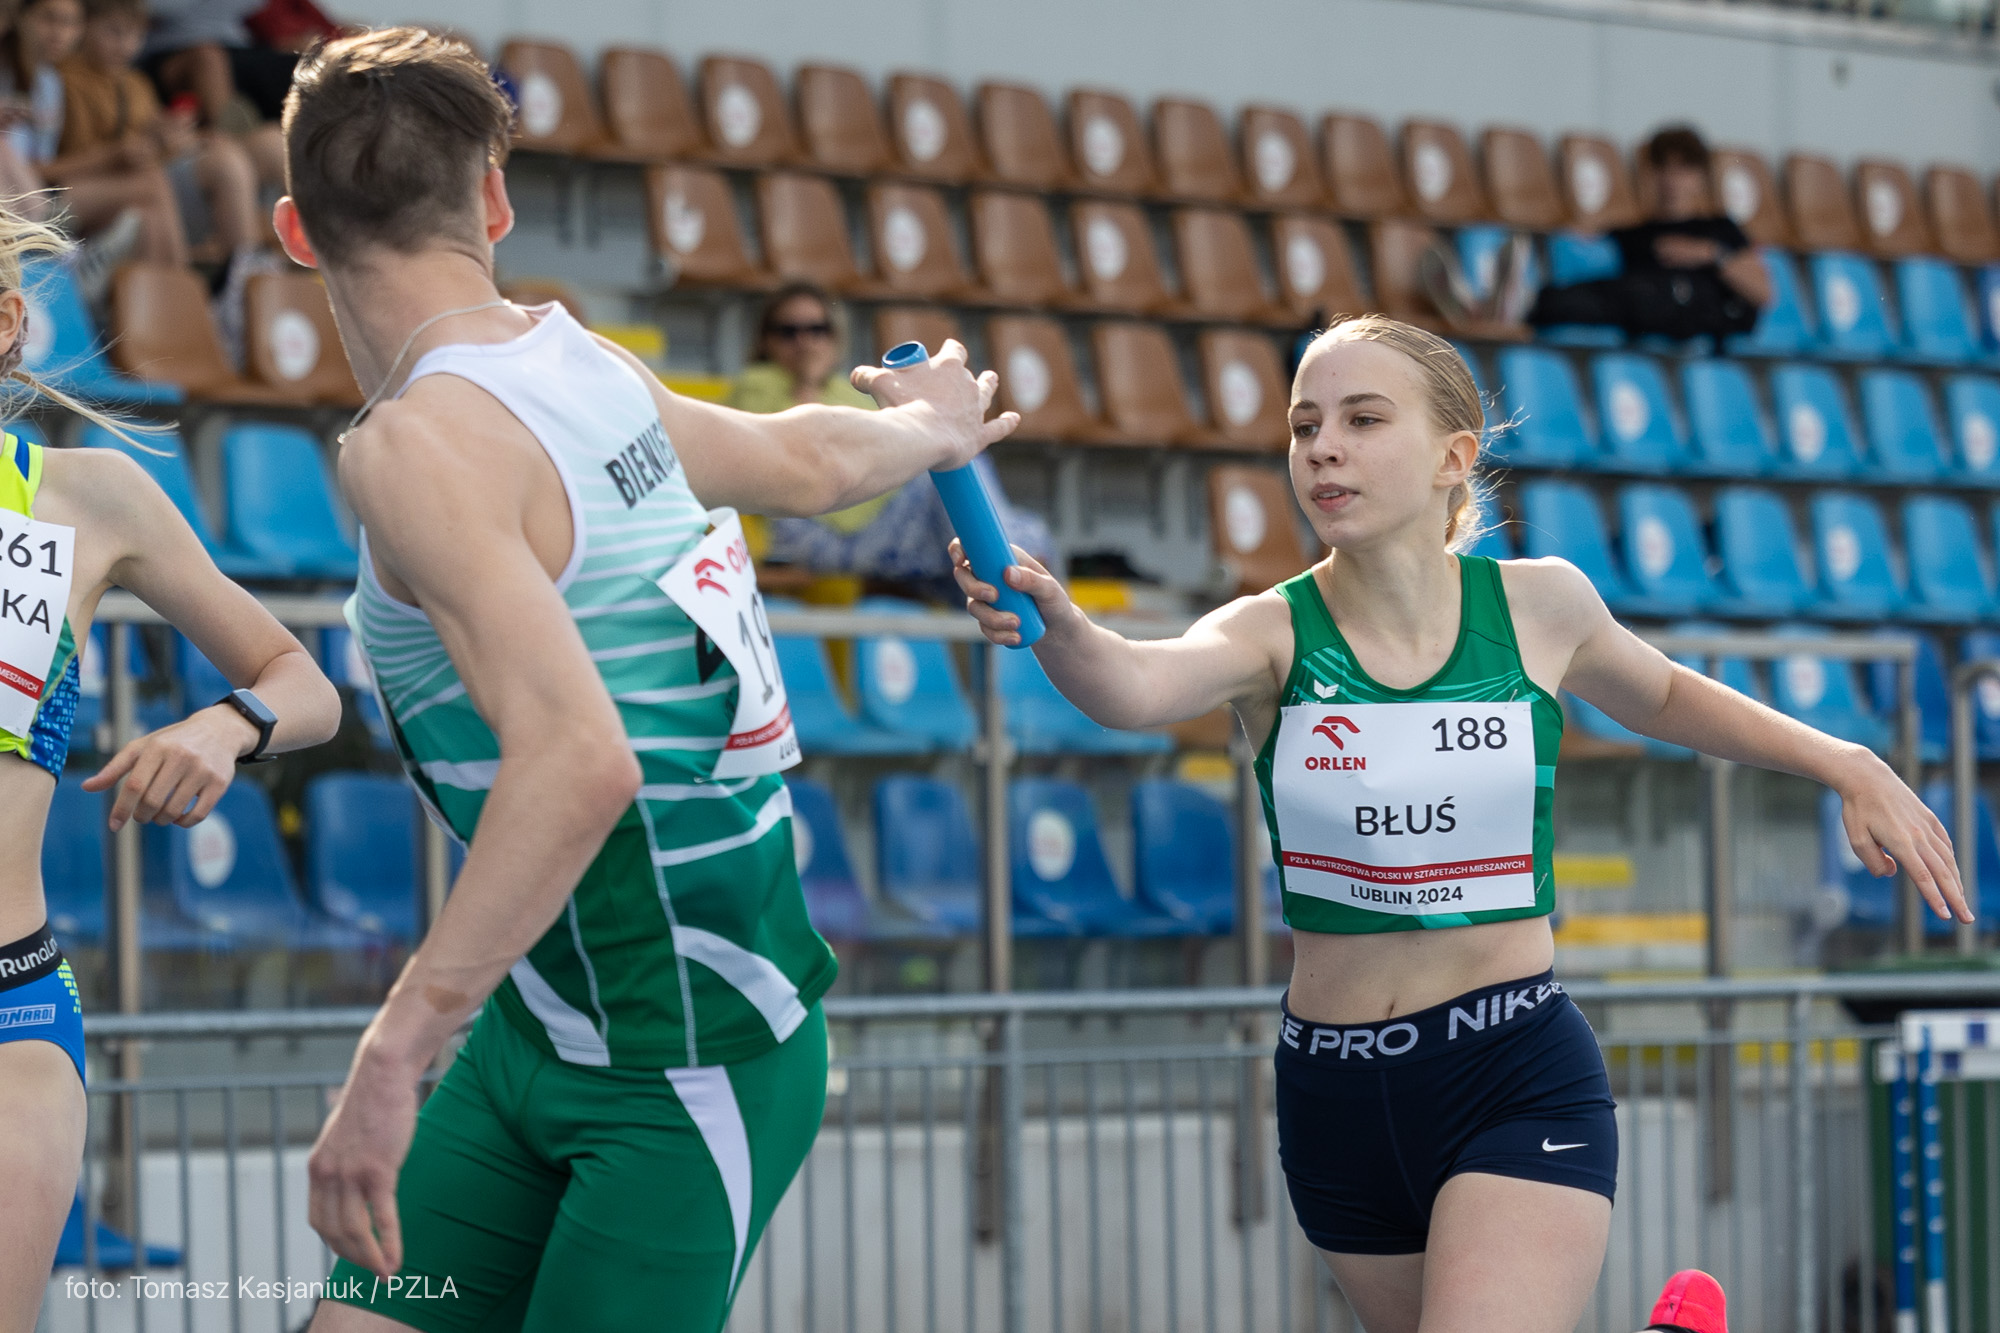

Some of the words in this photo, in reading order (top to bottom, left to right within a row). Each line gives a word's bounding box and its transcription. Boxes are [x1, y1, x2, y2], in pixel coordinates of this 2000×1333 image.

[0, 527, 63, 577] 61
[1, 588, 51, 635] KA
[1432, 716, 1508, 752] 188
[1305, 756, 1366, 771] ORLEN
[1355, 795, 1456, 836] BŁUŚ
[1290, 855, 1311, 865] PZLA
[1311, 858, 1371, 878] MISTRZOSTWA
[1371, 871, 1402, 880] POLSKI
[1403, 871, 1413, 880] W
[1414, 866, 1468, 879] SZTAFETACH
[1469, 860, 1526, 873] MIESZANYCH
[1350, 884, 1412, 905] LUBLIN
[1417, 886, 1464, 905] 2024
[1280, 1012, 1304, 1050] E
[1309, 1023, 1419, 1059] PRO
